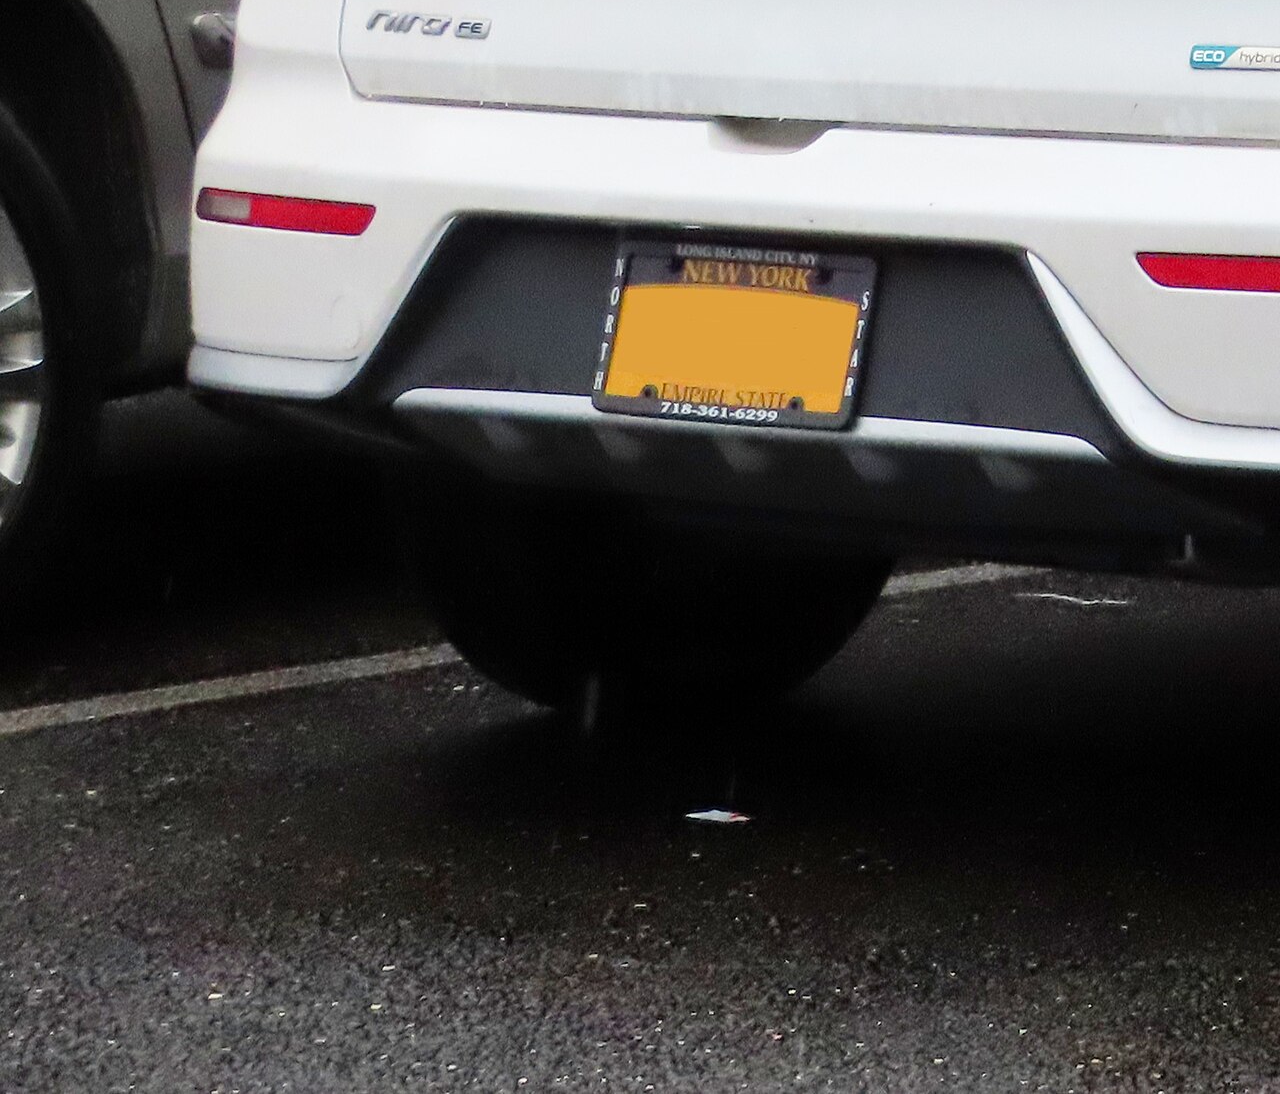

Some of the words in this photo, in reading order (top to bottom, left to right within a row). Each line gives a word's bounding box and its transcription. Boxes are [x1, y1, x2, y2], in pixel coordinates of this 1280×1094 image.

[458, 22, 484, 34] FE
[1192, 50, 1225, 63] ECO
[677, 244, 712, 257] LONG
[714, 247, 762, 261] ISLAND
[799, 253, 819, 266] NY
[682, 259, 742, 283] NEW
[748, 263, 812, 293] YORK
[660, 382, 727, 405] EMPIRE
[736, 390, 787, 409] STATE
[660, 401, 779, 422] 718-361-6299
